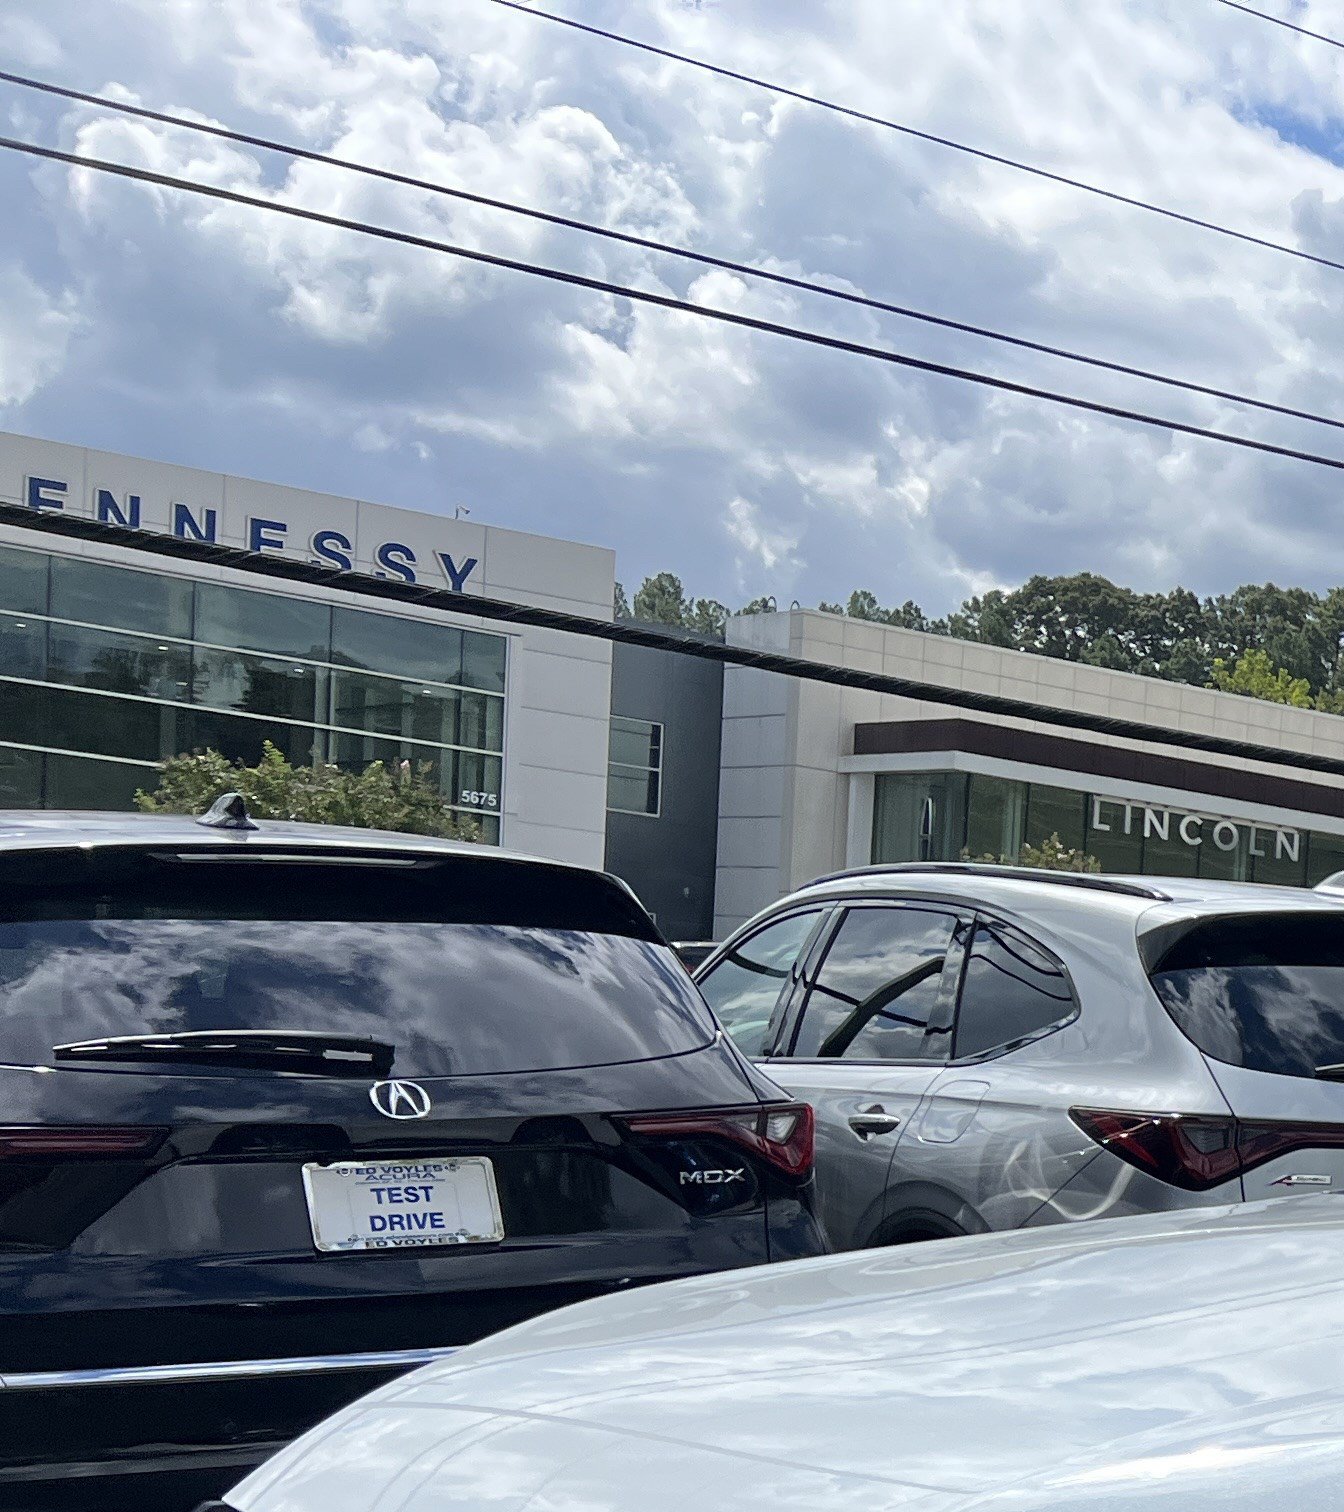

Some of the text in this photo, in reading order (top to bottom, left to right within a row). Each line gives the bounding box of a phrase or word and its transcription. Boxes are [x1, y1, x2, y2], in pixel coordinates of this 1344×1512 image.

[27, 474, 479, 594] ENNESSY
[461, 790, 497, 807] 5675
[1092, 795, 1300, 863] LINCOLN
[355, 1163, 443, 1176] ED VOYLES
[365, 1172, 436, 1181] ACURA
[679, 1167, 746, 1185] MDX
[370, 1185, 434, 1205] TEST
[369, 1211, 446, 1232] DRIVE
